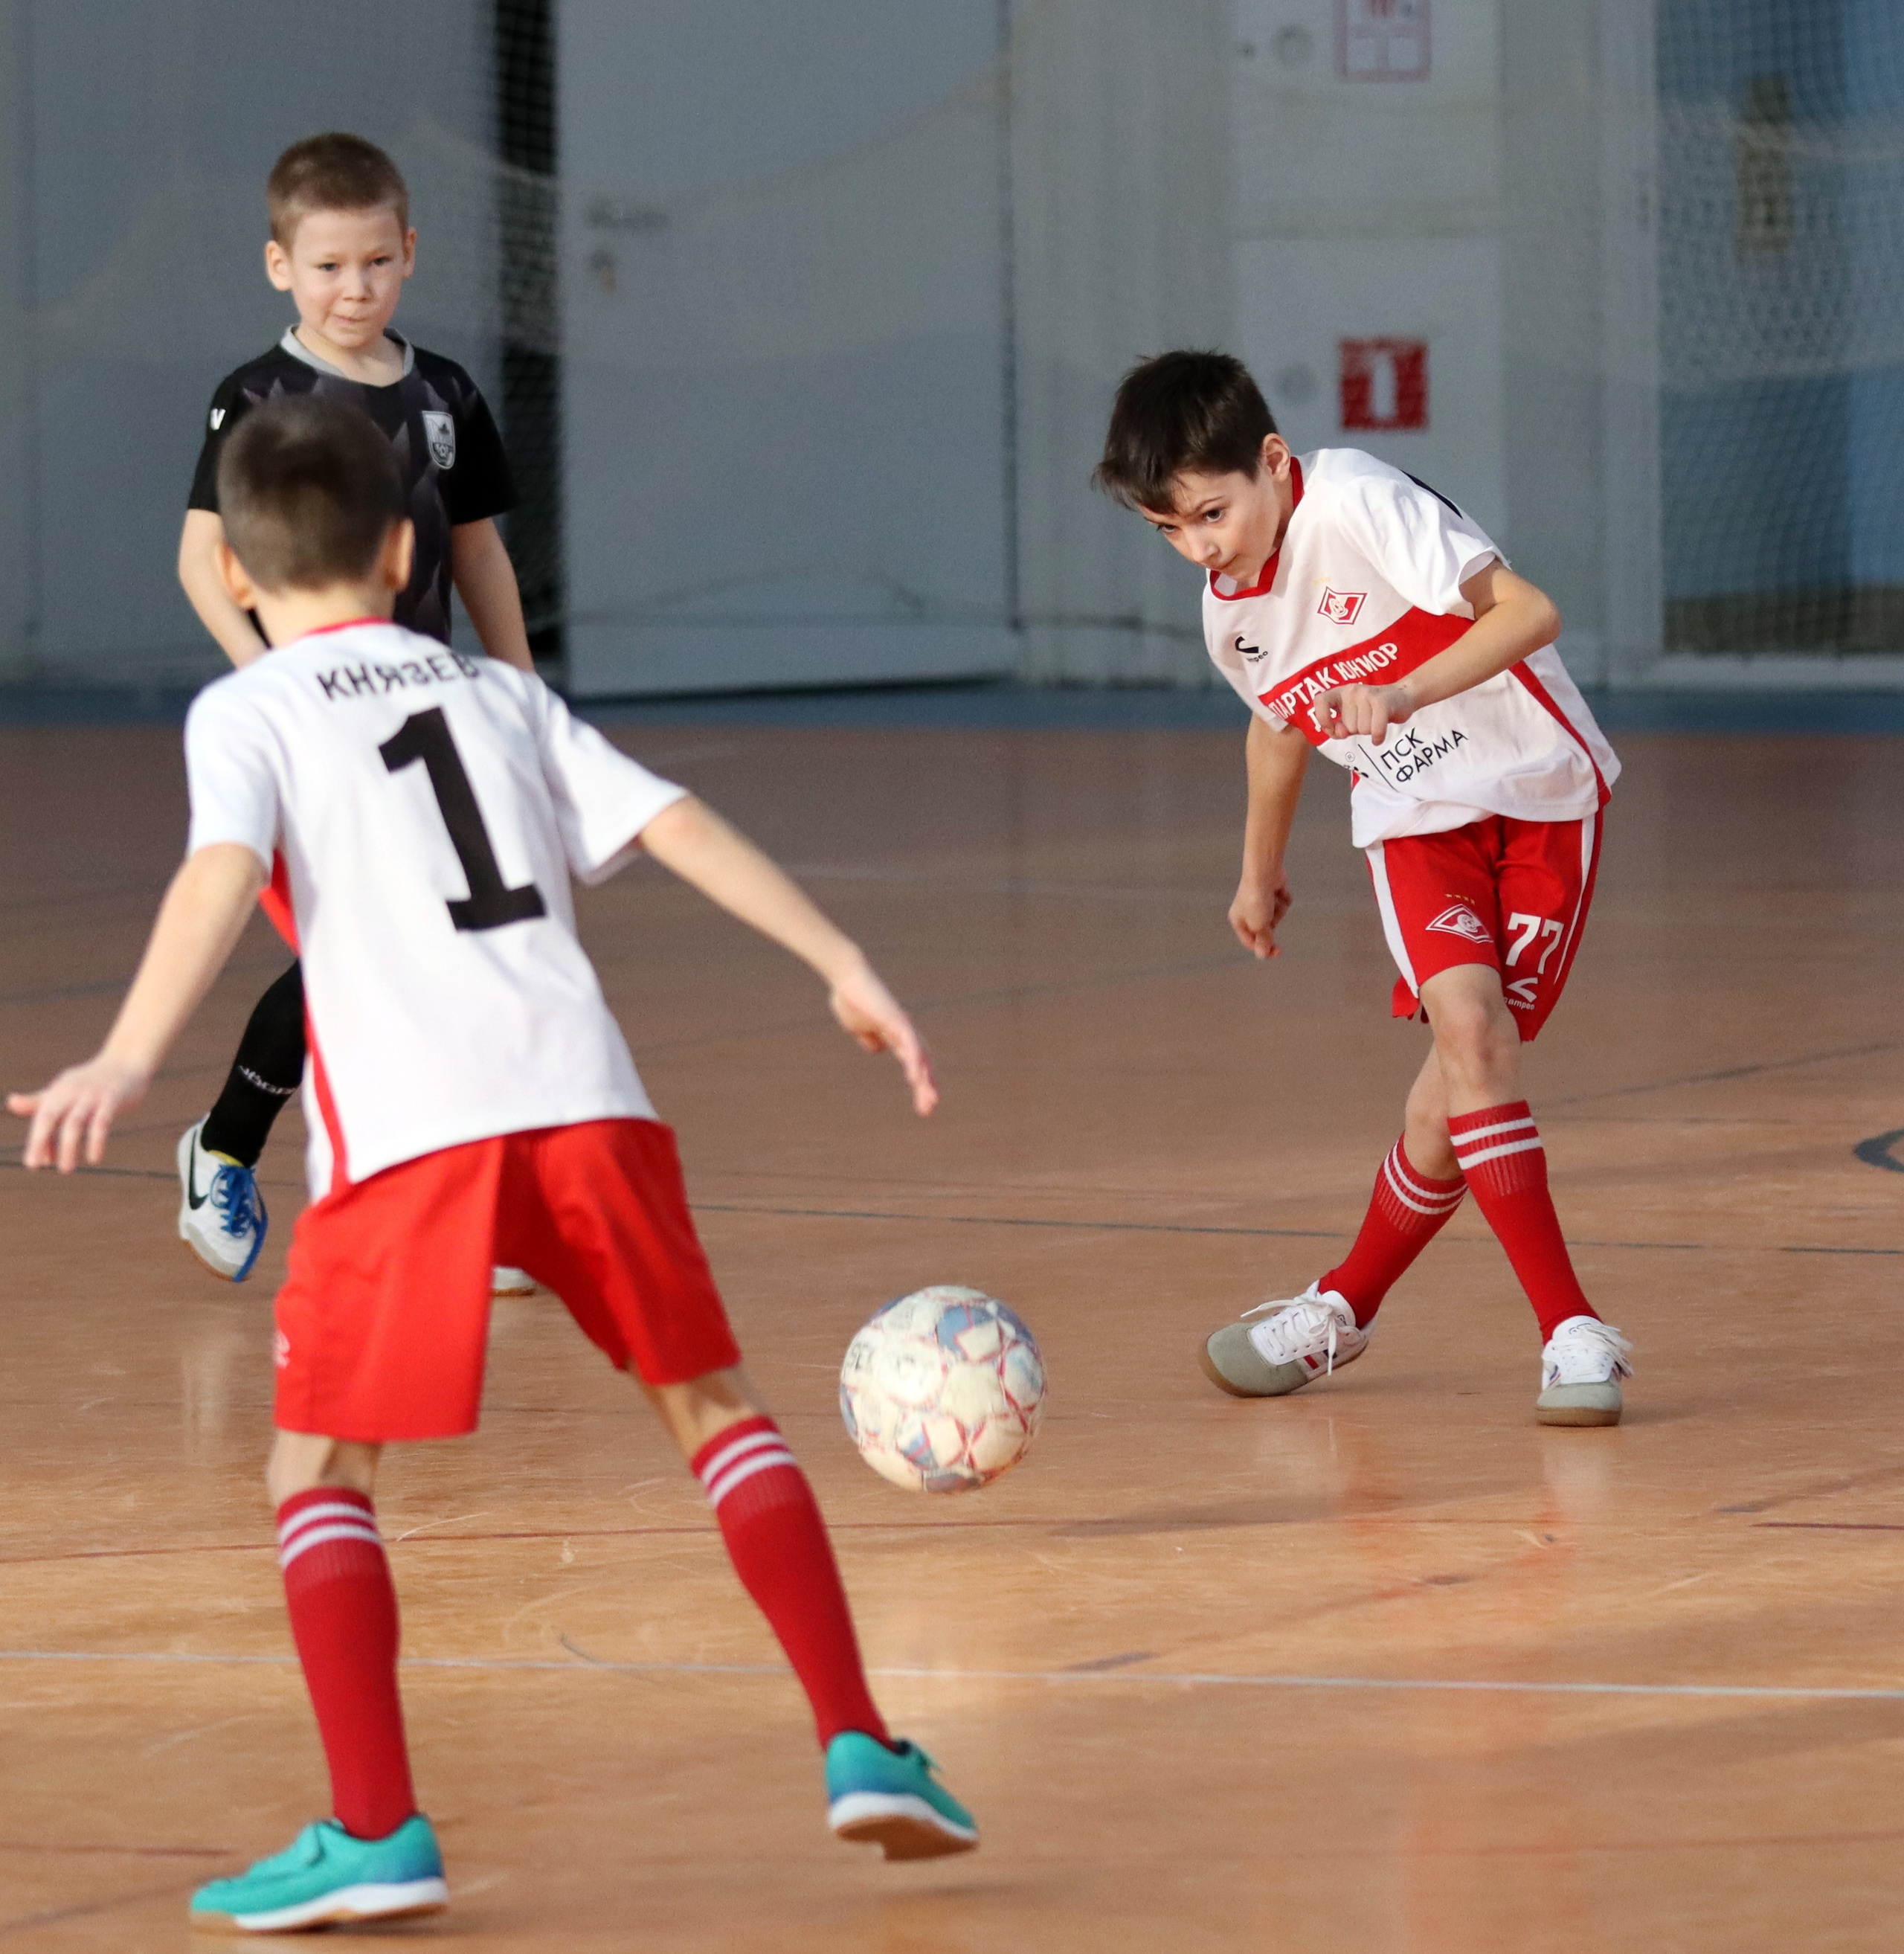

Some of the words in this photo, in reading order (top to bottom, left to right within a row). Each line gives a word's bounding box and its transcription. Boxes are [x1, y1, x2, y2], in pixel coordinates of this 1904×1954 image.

[316, 652, 480, 700] КНЯЗЕВ
[1267, 666, 1340, 720] ПАРТАК
[1333, 642, 1399, 681] ЮНИОР
[1380, 727, 1424, 771] ПСК
[1395, 729, 1470, 782] ФАРМА
[378, 706, 547, 932] 1
[1505, 911, 1565, 975] 77
